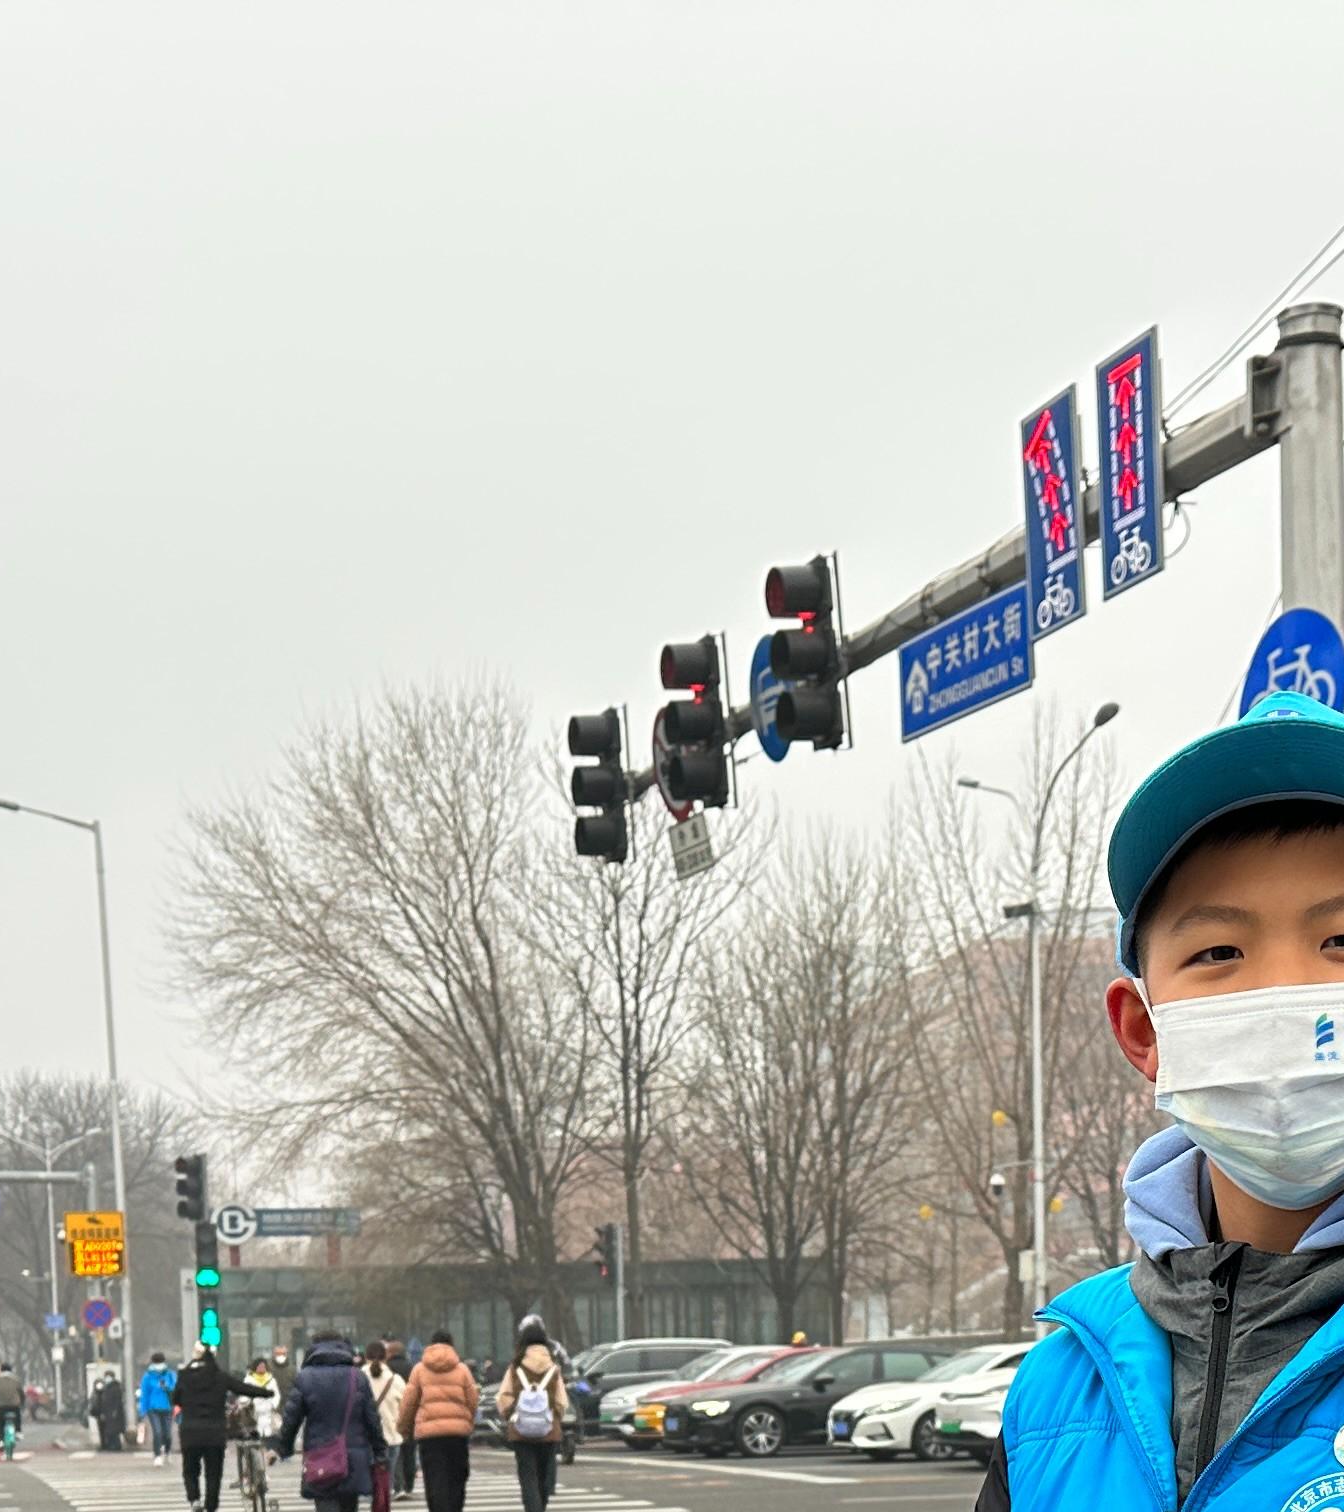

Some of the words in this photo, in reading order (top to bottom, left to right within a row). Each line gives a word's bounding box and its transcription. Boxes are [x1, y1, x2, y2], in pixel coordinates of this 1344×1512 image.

[926, 602, 1021, 680] 中关村大街
[928, 661, 1009, 714] ZHONGGUANCUN
[1011, 656, 1024, 677] St
